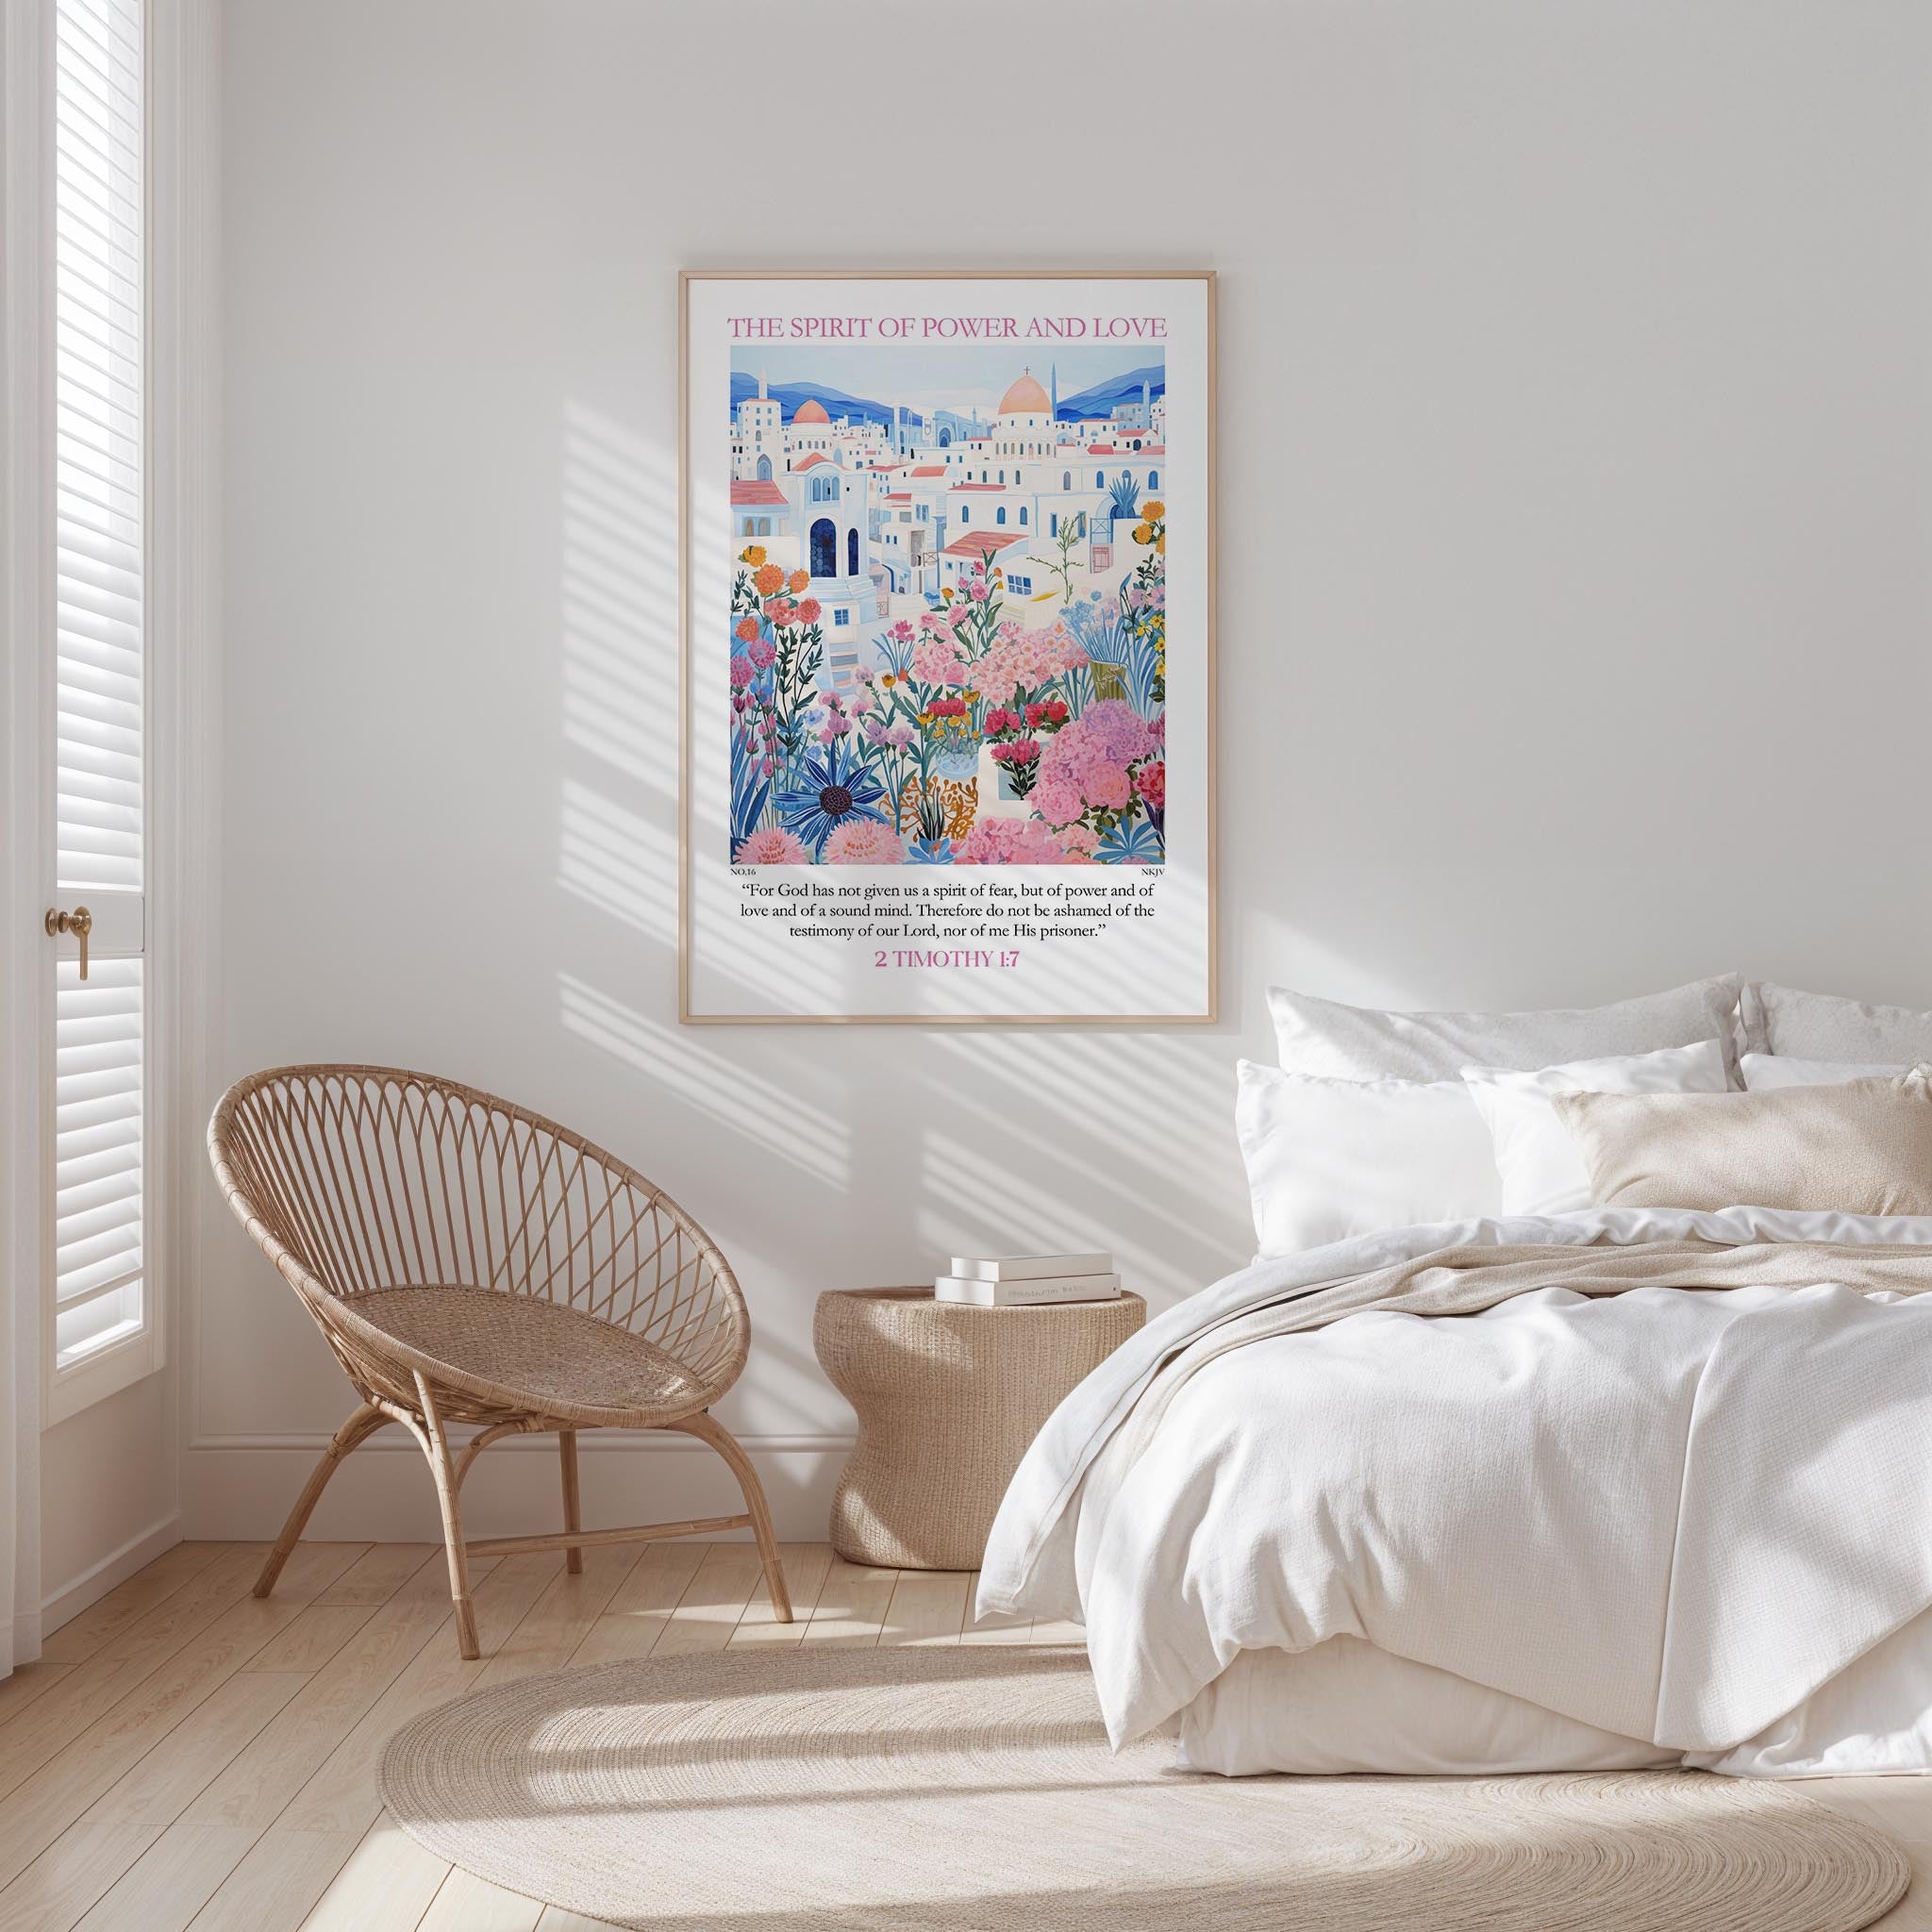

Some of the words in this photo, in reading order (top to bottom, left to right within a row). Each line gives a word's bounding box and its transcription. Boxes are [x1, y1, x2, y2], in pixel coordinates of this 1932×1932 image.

[727, 318, 784, 337] THE
[791, 318, 872, 337] SPIRIT
[878, 318, 915, 337] OF
[922, 318, 1019, 337] POWER
[1025, 317, 1086, 337] AND
[1093, 318, 1167, 337] LOVE
[1141, 868, 1165, 877] NKJV
[778, 883, 808, 896] God
[812, 884, 834, 896] has
[838, 887, 861, 897] not
[863, 884, 900, 900] given
[904, 888, 918, 896] us
[923, 888, 930, 896] a
[934, 884, 967, 900] spirit
[971, 883, 986, 896] of
[989, 883, 1017, 899] fear,
[1021, 884, 1043, 896] but
[1047, 883, 1063, 896] of
[1065, 888, 1108, 900] power
[1110, 884, 1136, 896] and
[1140, 883, 1155, 896] of
[741, 904, 769, 916] love
[773, 904, 796, 916] and
[801, 904, 817, 916] of
[819, 908, 826, 916] a
[830, 904, 871, 916] sound
[874, 904, 911, 916] mind.
[916, 904, 982, 916] Therefore
[986, 904, 1004, 916] do
[1008, 907, 1030, 916] not
[1034, 904, 1050, 916] be
[1054, 903, 1111, 916] ashamed
[1116, 904, 1132, 916] of
[1134, 904, 1155, 916] the
[790, 924, 855, 941] testimony
[858, 924, 874, 937] of
[876, 928, 900, 937] our
[903, 924, 940, 939] Lord,
[943, 928, 967, 937] nor
[971, 924, 987, 937] of
[1013, 924, 1036, 937] His
[875, 951, 887, 967] 2
[892, 951, 993, 967] TIMOTHY
[1000, 951, 1020, 967] 1:7
